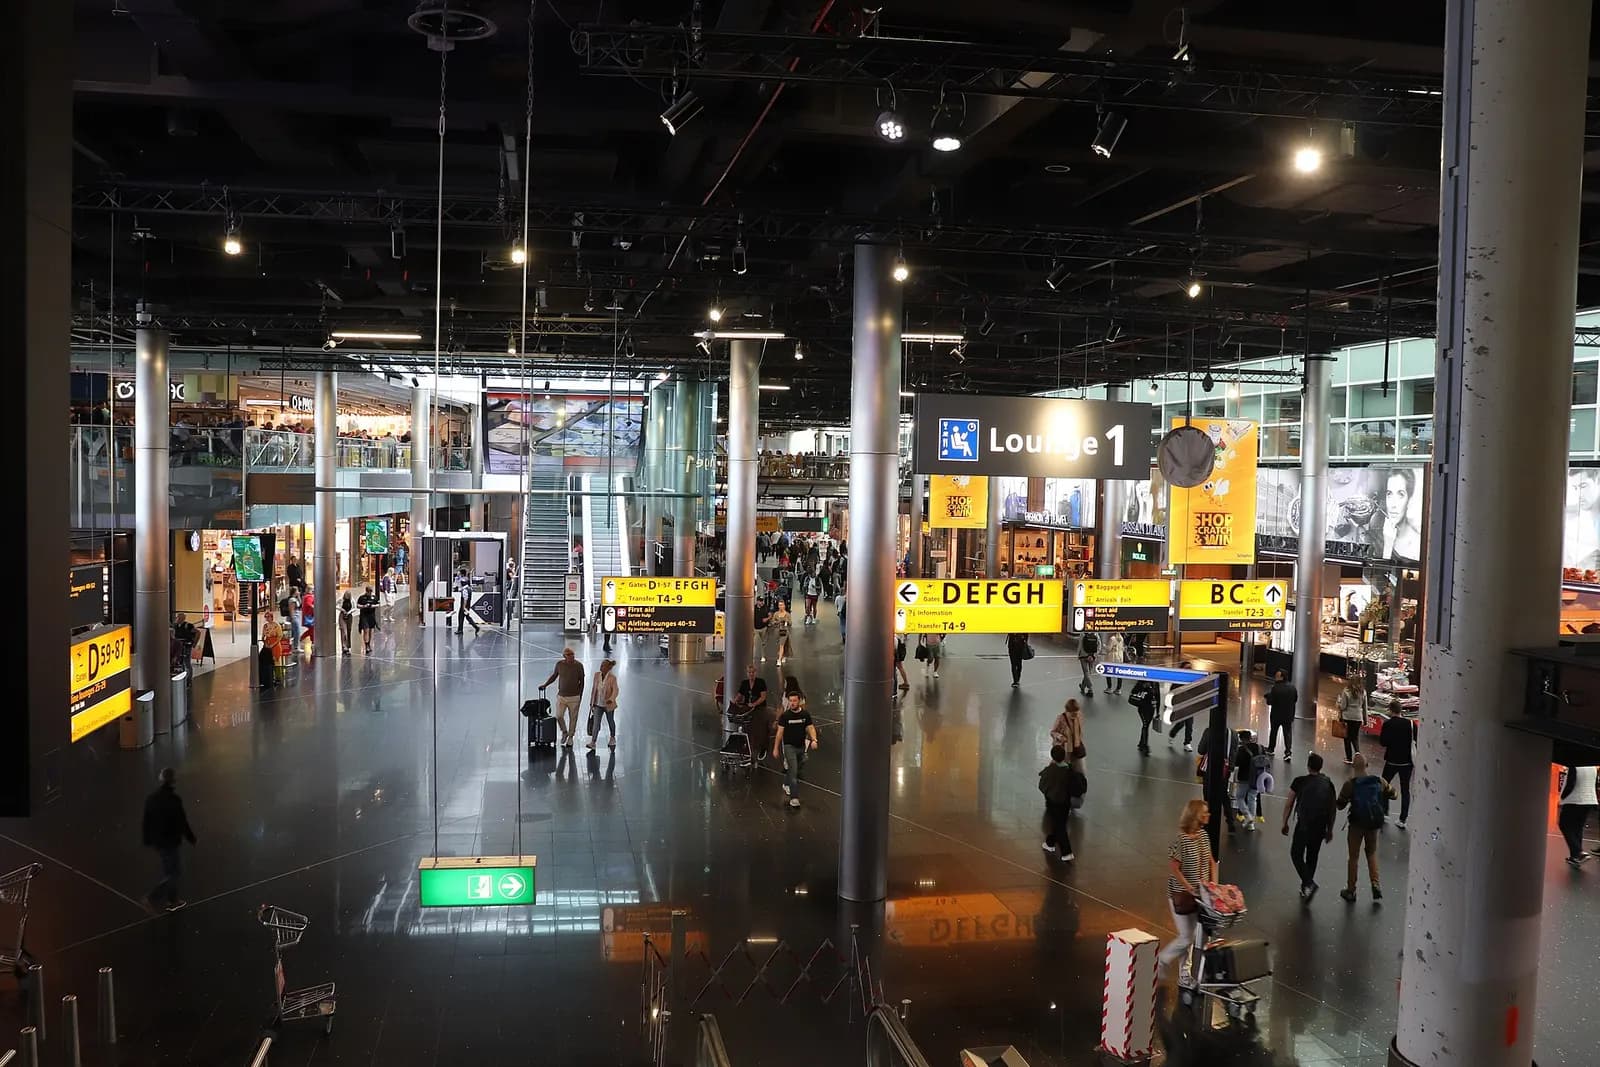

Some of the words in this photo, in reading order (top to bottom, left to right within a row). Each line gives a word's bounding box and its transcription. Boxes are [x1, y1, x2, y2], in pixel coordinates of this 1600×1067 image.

[1105, 424, 1124, 466] 1
[945, 496, 972, 504] SHOP
[1194, 513, 1233, 527] SHOP
[1194, 526, 1232, 535] SCRATCH
[1205, 534, 1232, 545] WIN
[656, 595, 683, 604] T4-9
[1245, 608, 1265, 617] T2-3
[650, 620, 677, 629] lounges
[942, 621, 967, 631] T4-9
[1115, 667, 1148, 677] Foodcourt
